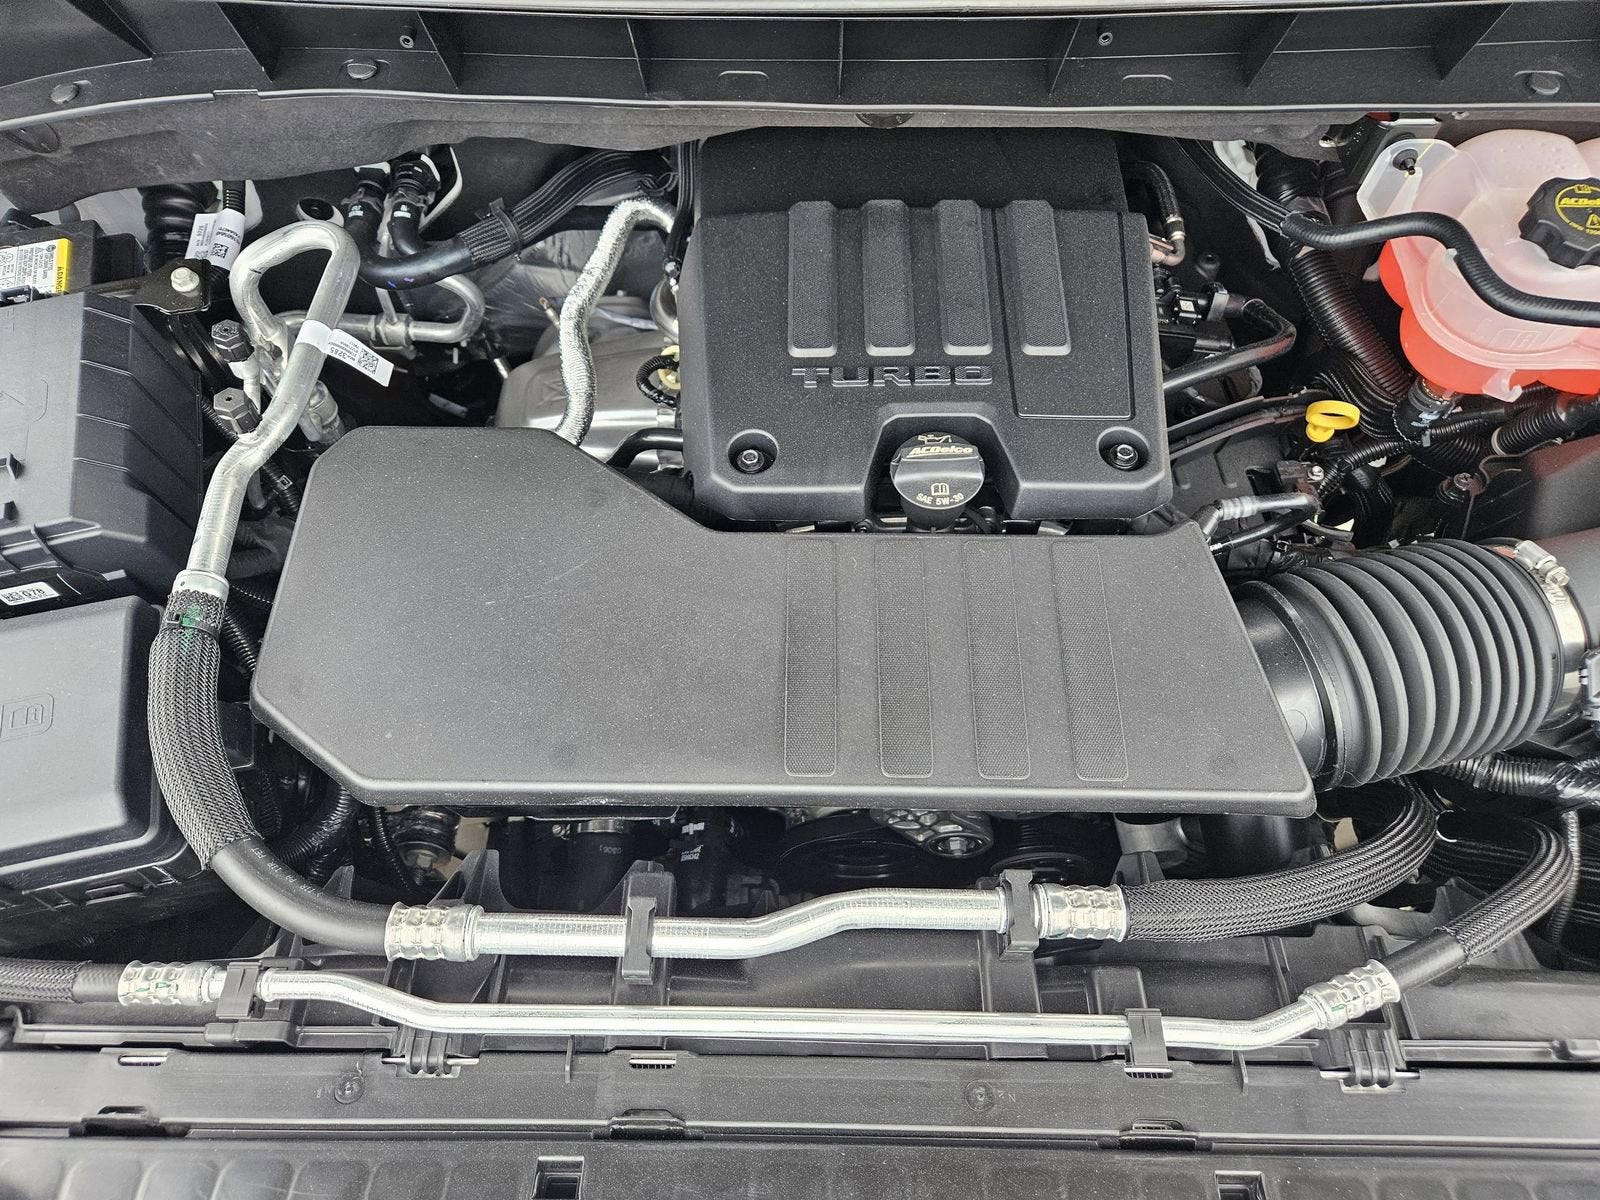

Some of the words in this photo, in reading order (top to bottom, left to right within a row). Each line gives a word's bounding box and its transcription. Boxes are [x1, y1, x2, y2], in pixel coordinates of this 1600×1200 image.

[791, 366, 993, 388] TURBO
[907, 446, 974, 456] ACDelco
[916, 493, 933, 504] SAE
[935, 492, 964, 505] 5W-30
